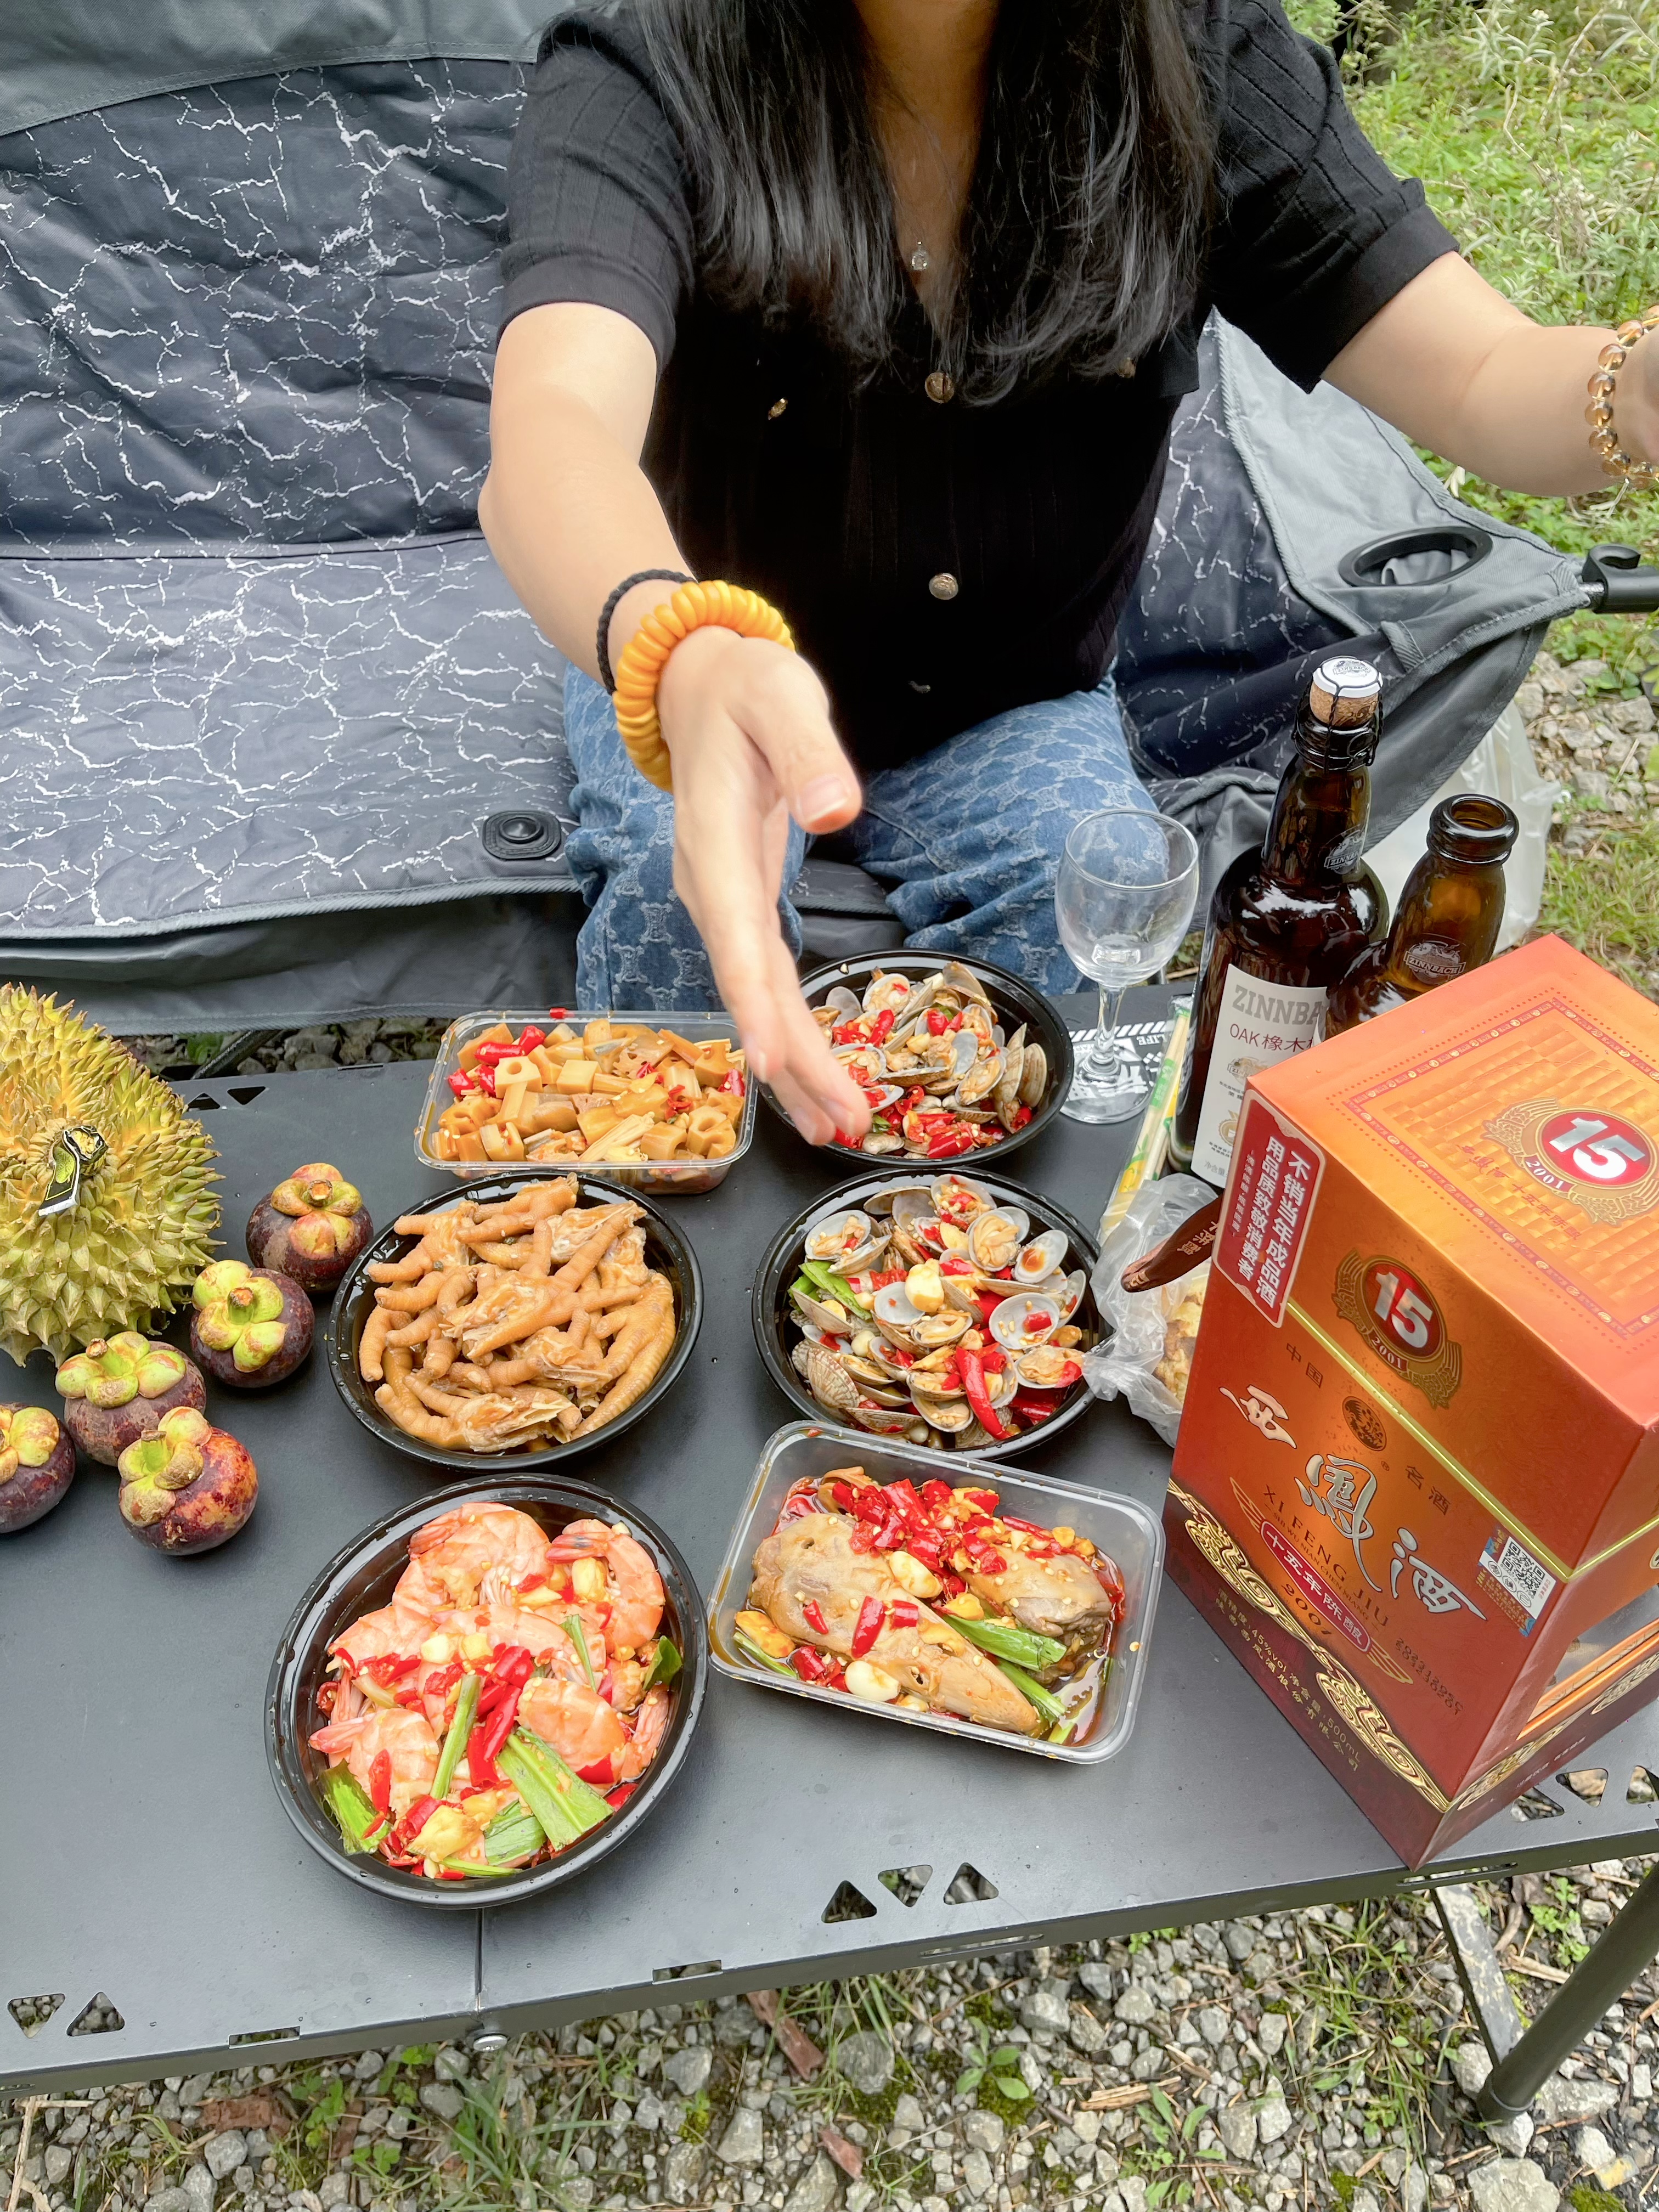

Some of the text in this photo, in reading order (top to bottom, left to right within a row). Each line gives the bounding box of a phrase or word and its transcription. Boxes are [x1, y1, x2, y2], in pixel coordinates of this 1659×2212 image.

[1408, 957, 1460, 974] ZINNBACH
[1229, 1023, 1261, 1047] OAK
[1525, 1159, 1566, 1190] 2001
[1549, 1118, 1645, 1179] 15
[1237, 1136, 1285, 1282] 用品质致敬消费者
[1256, 1151, 1311, 1308] 不销当年成品酒
[1374, 1272, 1434, 1348] 15
[1372, 1336, 1402, 1369] 2001
[1286, 1342, 1451, 1516] 中国 名酒
[1263, 1484, 1389, 1627] XI FENG JIU
[1266, 1531, 1363, 1646] 十五年陈酿
[1286, 1527, 1299, 1543] WU
[1300, 1543, 1319, 1565] NIAN
[1321, 1565, 1342, 1590] CHEN
[1343, 1591, 1368, 1620] NIANG
[1282, 1583, 1333, 1635] 2001
